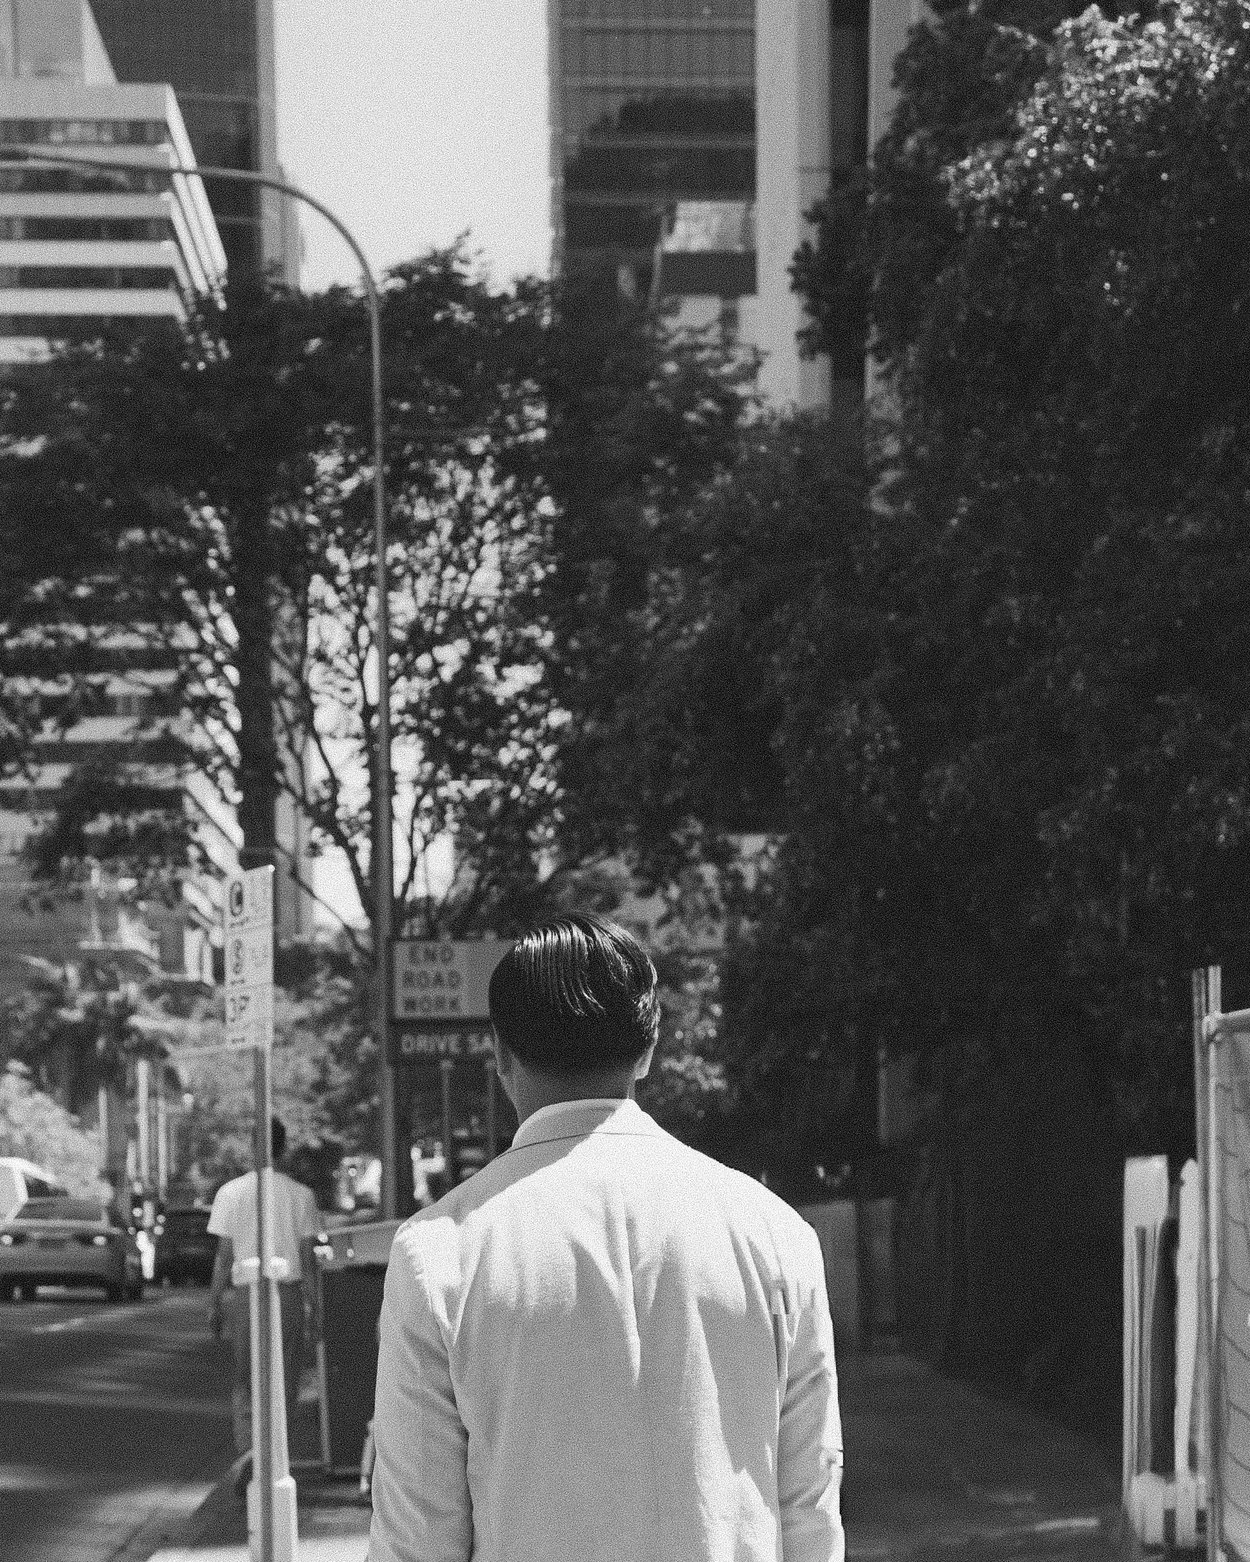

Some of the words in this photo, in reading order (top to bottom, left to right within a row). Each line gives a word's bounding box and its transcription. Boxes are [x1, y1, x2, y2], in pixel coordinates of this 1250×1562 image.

[409, 945, 455, 965] END
[402, 970, 463, 989] ROAD
[401, 1033, 461, 1055] DRIVE
[467, 1033, 494, 1054] SA
